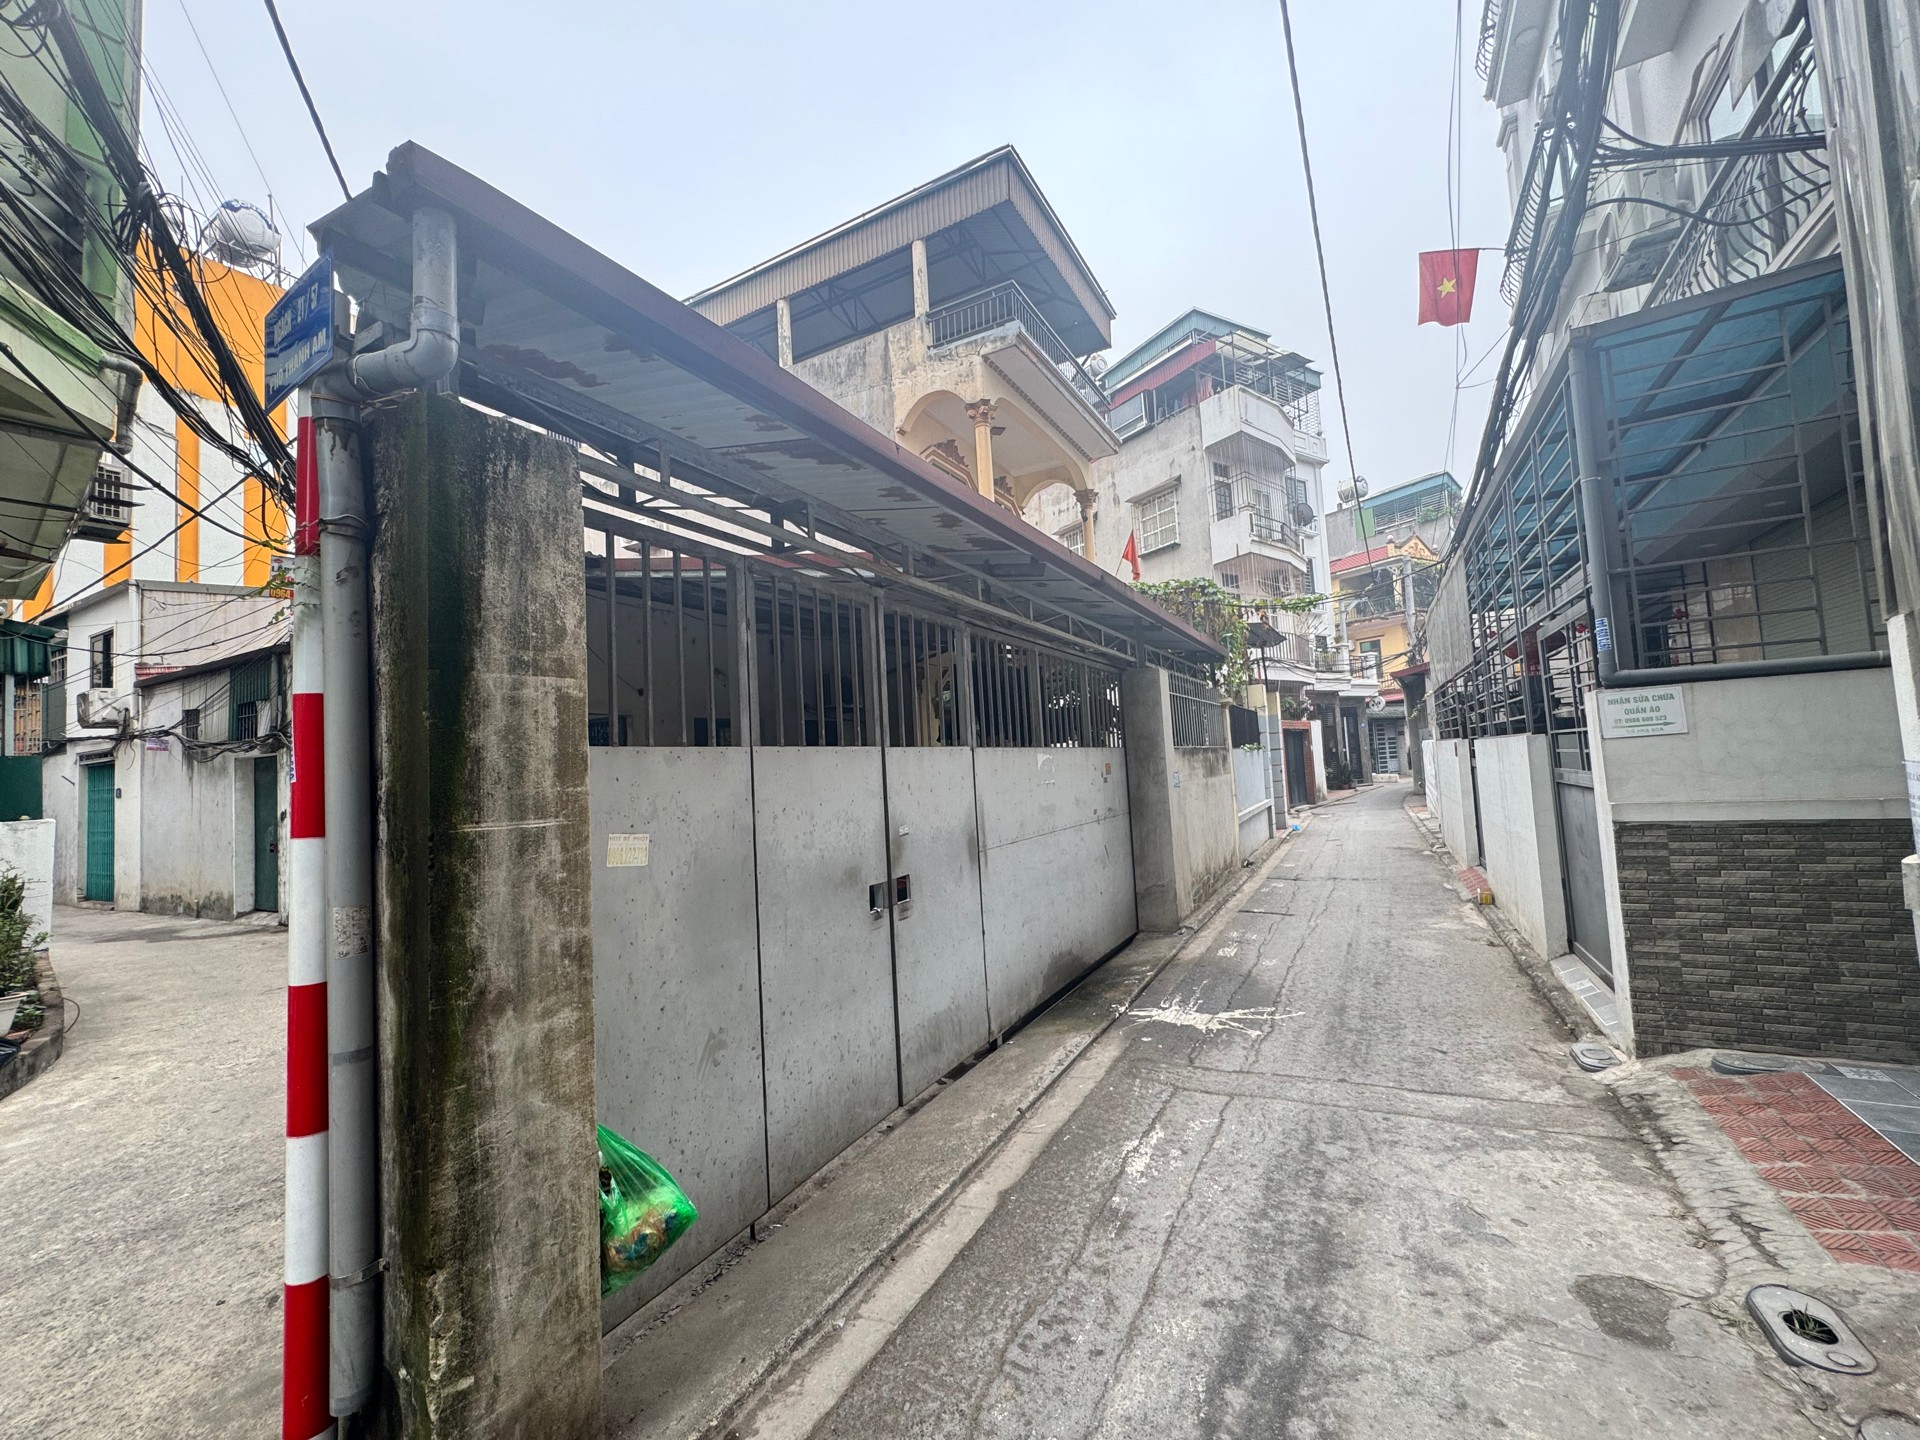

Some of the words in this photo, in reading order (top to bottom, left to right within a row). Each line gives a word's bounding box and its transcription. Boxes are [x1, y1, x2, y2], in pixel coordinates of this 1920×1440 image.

[285, 344, 310, 379] THANH
[311, 328, 327, 353] AM
[1633, 693, 1650, 704] SỬA
[1652, 693, 1675, 702] CHỮA
[1649, 705, 1661, 713] ÁO
